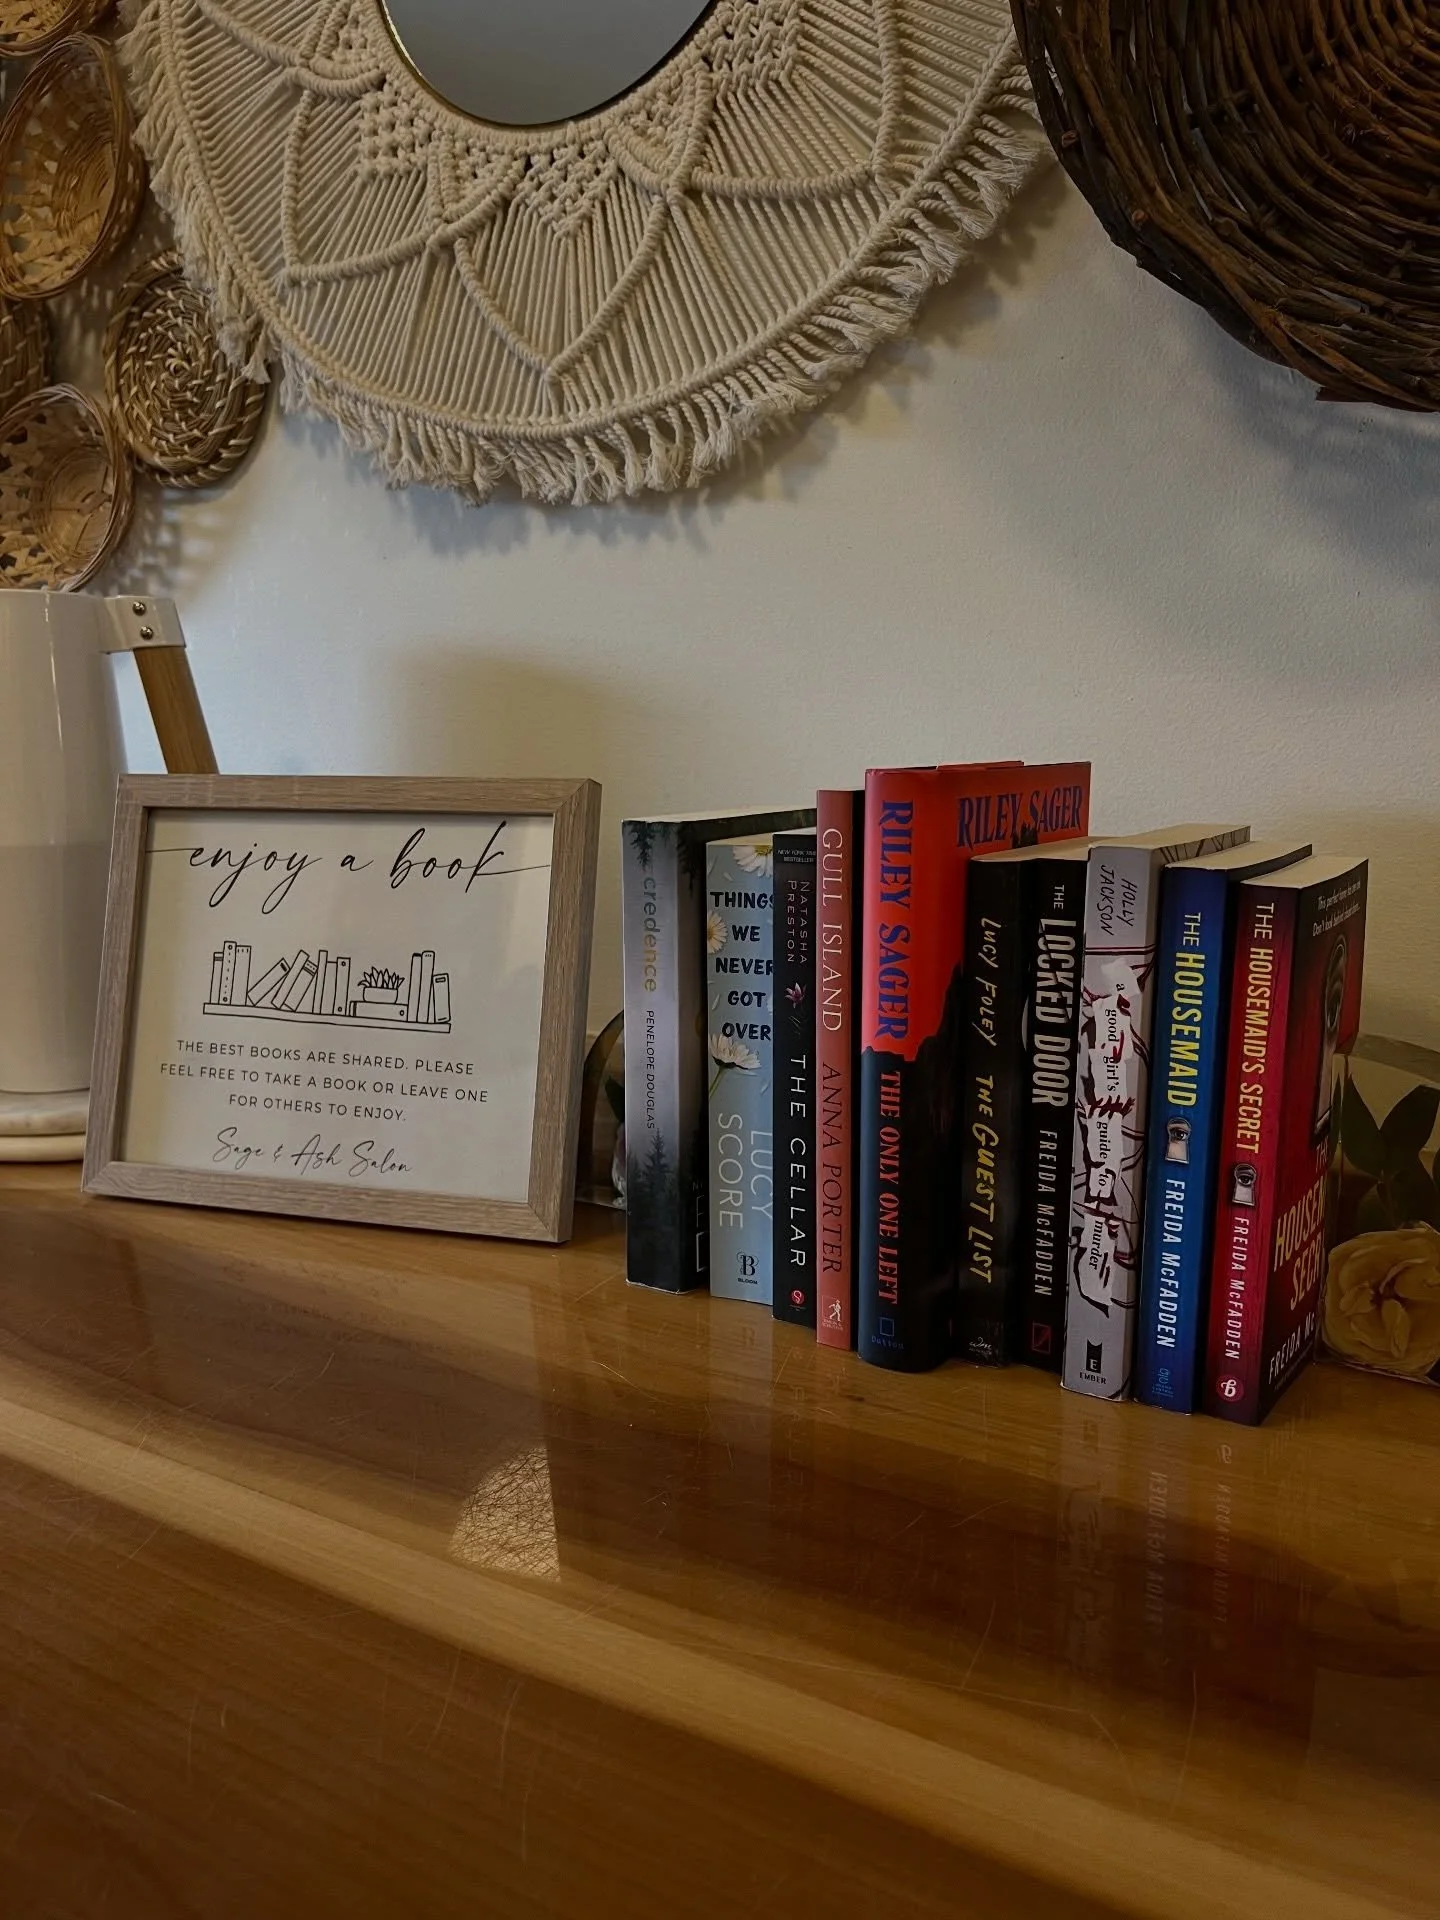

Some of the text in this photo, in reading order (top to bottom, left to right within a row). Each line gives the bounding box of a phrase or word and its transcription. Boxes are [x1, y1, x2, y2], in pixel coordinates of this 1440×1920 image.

[956, 785, 1083, 850] RILEY SAGER
[146, 820, 550, 914] enjoy a book
[1097, 865, 1115, 936] JACKSON
[1117, 878, 1138, 927] HOLLY
[643, 877, 661, 992] credence
[732, 925, 760, 941] WE
[787, 880, 798, 962] PRESTON
[800, 881, 811, 964] NATASHA
[822, 828, 843, 1031] GULL ISLAND
[874, 800, 914, 1041] RILEY SAGER
[727, 991, 766, 1008] GOT
[972, 976, 998, 1047] FOLEY
[1032, 884, 1077, 1107] THE LOCKED DOOR
[1116, 983, 1125, 991] a
[1167, 911, 1206, 1107] THE HOUSEMAID
[177, 1040, 474, 1075] THE BEST BOOKS ARE SHARED. PLEASE
[722, 1022, 771, 1041] OVER
[1105, 1009, 1120, 1043] good
[1236, 902, 1275, 1154] THE HOUSEMAID'S SECRET
[160, 1063, 488, 1103] FEEL FREE TO TAKE A BOOK OR LEAVE ONE
[646, 1010, 655, 1129] PENELOPE DOUGLAS
[1103, 1055, 1119, 1092] girl's
[229, 1094, 406, 1121] FOR OTHERS TO ENJOY.
[1097, 1122, 1111, 1159] guide
[212, 1126, 412, 1177] Sage & Ash Salon
[718, 1113, 744, 1229] SCORE
[751, 1130, 773, 1220] LUCY
[790, 1054, 806, 1267] THE CELLAR
[823, 1062, 843, 1273] ANNA PORTER
[968, 1075, 999, 1283] THE GUEST LIST
[1098, 1173, 1109, 1187] to
[878, 1070, 901, 1305] THE ONLY ONE LEFT
[1034, 1129, 1058, 1296] FREIDA McFADDEN
[1162, 1178, 1185, 1244] FREIDA
[737, 1277, 758, 1285] BLOOM
[1156, 1251, 1181, 1349] McFADDEN
[1224, 1216, 1250, 1360] FREIDA McFADDEN
[1079, 1371, 1107, 1385] EMBER
[1268, 1324, 1301, 1385] FREIDA
